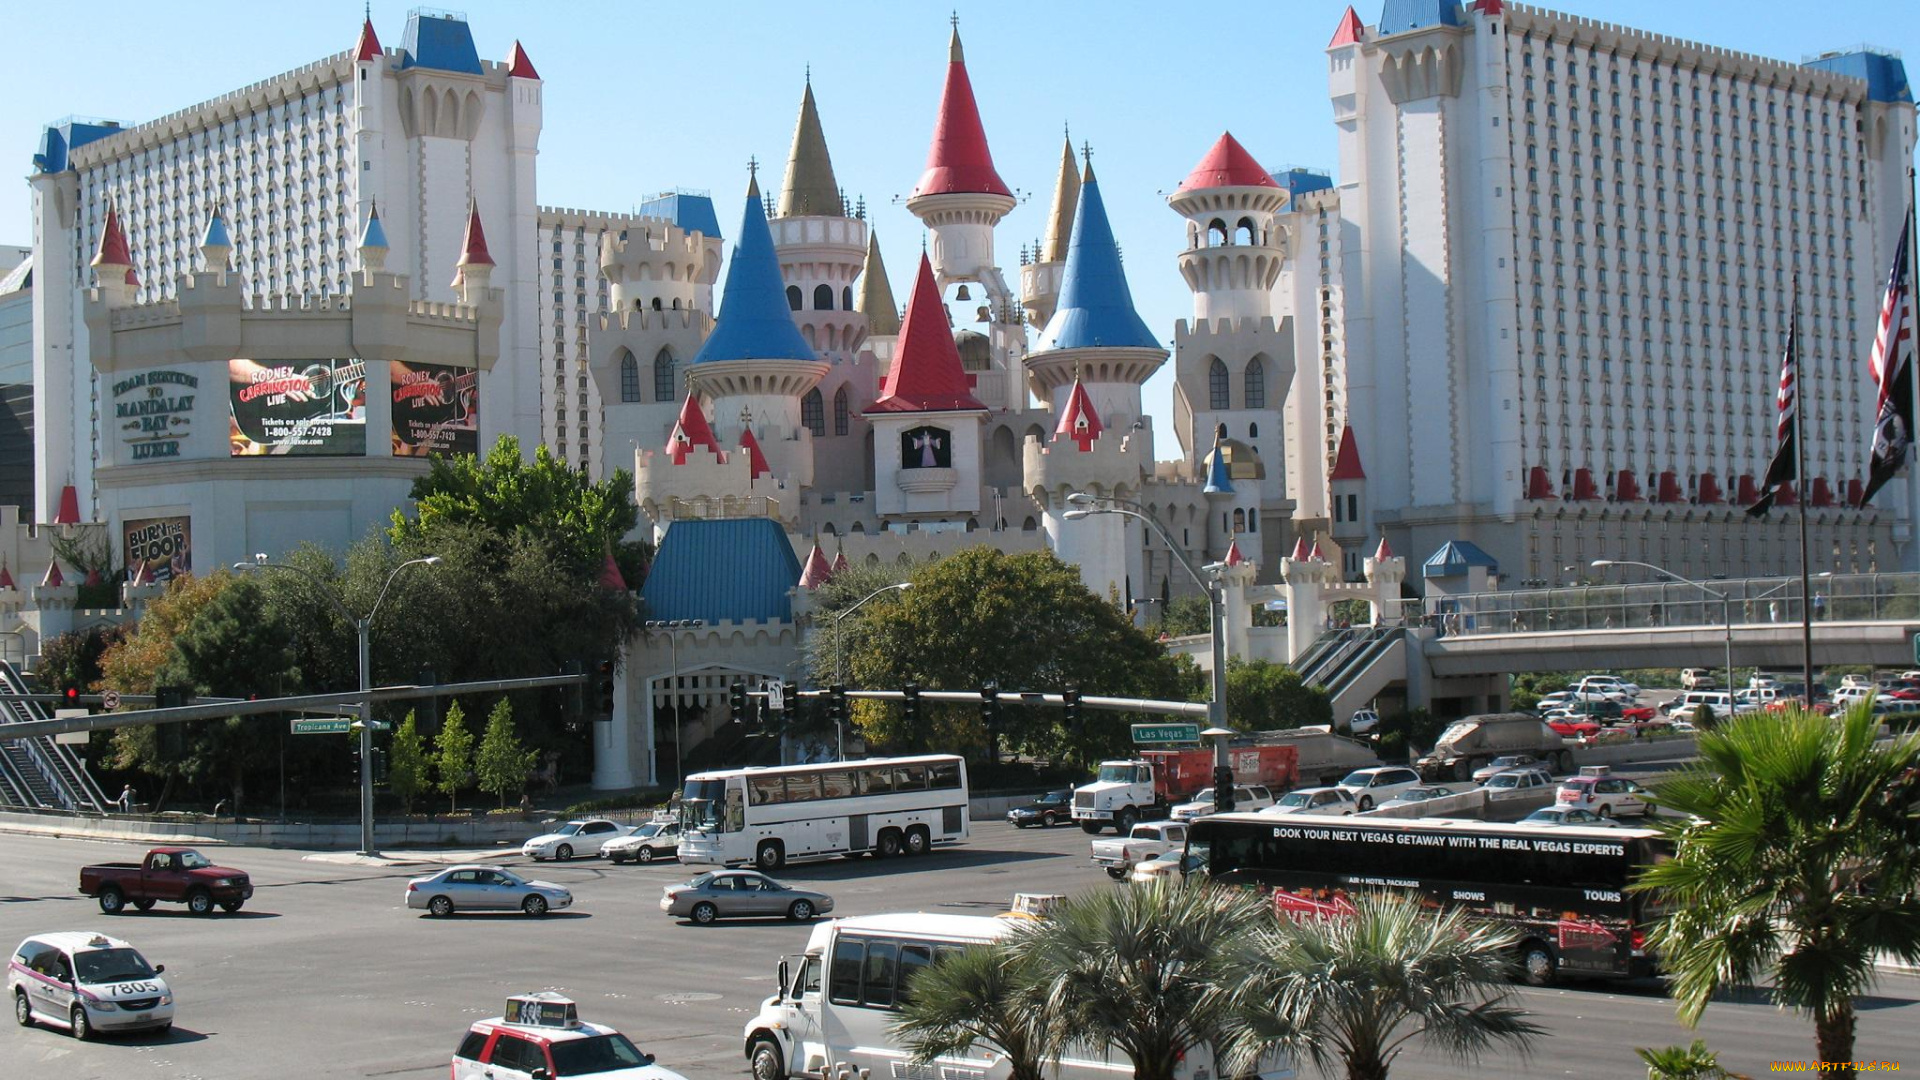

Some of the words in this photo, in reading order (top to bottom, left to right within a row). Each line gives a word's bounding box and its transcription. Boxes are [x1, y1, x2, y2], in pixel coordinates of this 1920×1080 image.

[251, 366, 295, 384] RODNEY
[401, 371, 430, 385] RODNEY
[112, 373, 146, 397] TRAM
[147, 371, 199, 389] STATION
[239, 379, 310, 402] CARRINGTON
[147, 386, 163, 398] TO
[393, 383, 441, 403] CARRINGTON
[116, 395, 195, 418] MANDALAY
[266, 393, 286, 407] LIVE
[412, 397, 425, 408] LIVE
[141, 415, 169, 432] BAY
[261, 418, 284, 426] Tickets
[264, 427, 332, 437] 1-800-557-7428
[131, 441, 180, 459] LUXOR
[129, 522, 167, 546] BURN
[167, 521, 182, 534] THE
[130, 533, 185, 561] FLOOR
[296, 723, 331, 731] Tropicana
[1139, 730, 1156, 739] Las
[1158, 729, 1183, 740] Vegas
[1273, 827, 1301, 838] BOOK
[1303, 829, 1330, 840] YOUR
[1332, 831, 1358, 842] NEXT
[1361, 832, 1394, 843] VEGAS
[1396, 834, 1446, 846] GETAWAY
[1448, 837, 1477, 848] WITH
[1478, 838, 1500, 849] THE
[1502, 839, 1531, 850] REAL
[1533, 841, 1571, 853] VEGAS
[1573, 843, 1624, 856] EXPERTS
[1365, 878, 1386, 886] HOTEL
[1386, 879, 1420, 888] PACKAGES
[1453, 890, 1485, 901] SHOWS
[1584, 890, 1621, 902] TOURS
[104, 981, 159, 997] 7805
